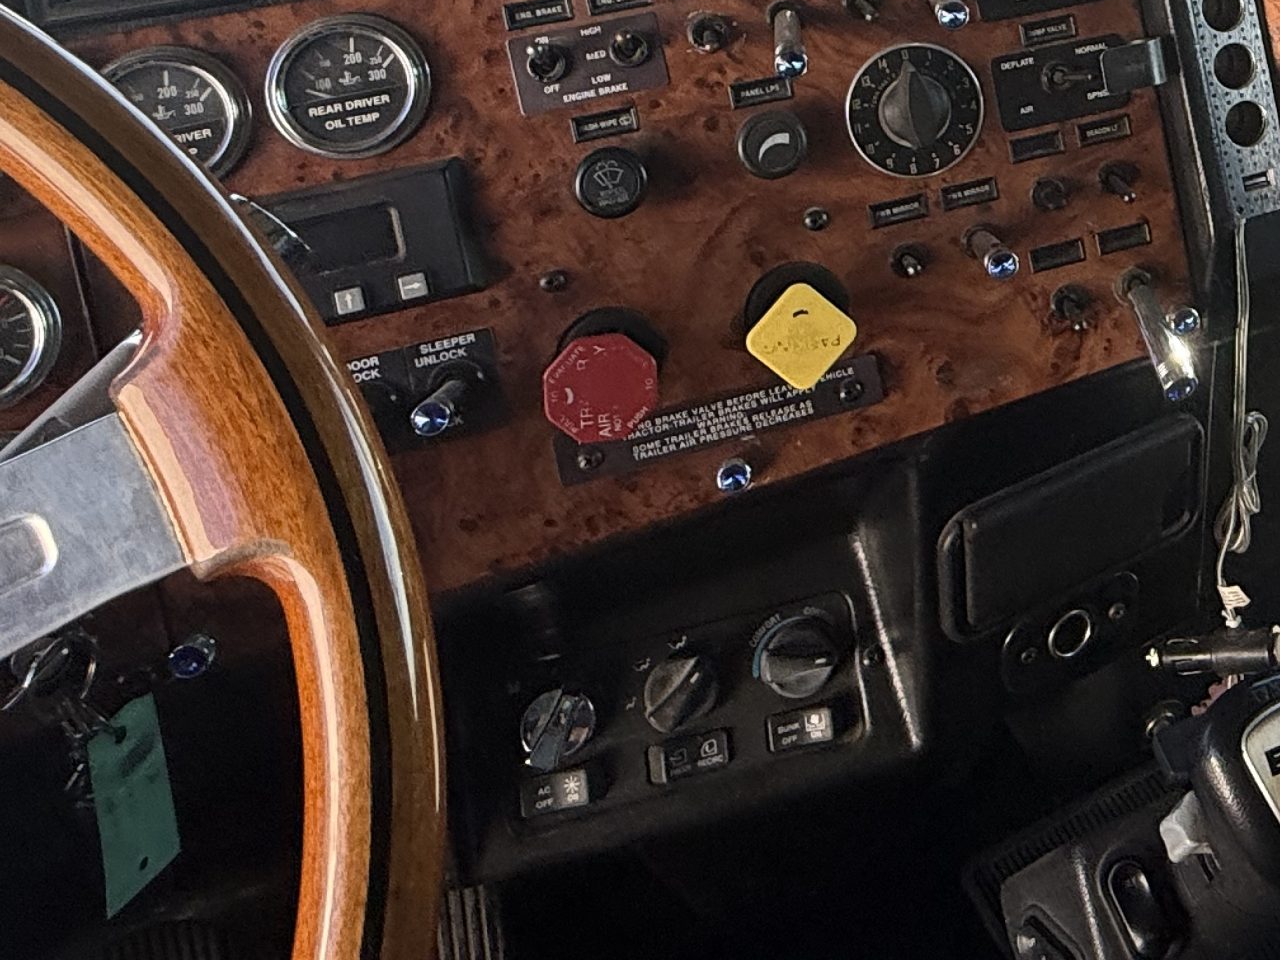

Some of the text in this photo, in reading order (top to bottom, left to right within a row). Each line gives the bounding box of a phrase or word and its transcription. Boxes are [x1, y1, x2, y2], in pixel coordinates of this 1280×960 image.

[535, 5, 563, 17] BRAKE
[580, 25, 602, 37] HIGH
[343, 52, 363, 65] 200
[585, 49, 606, 61] MED
[1000, 42, 1108, 71] DEFLATE NORMAL
[877, 58, 888, 70] 14
[367, 68, 387, 82] 300
[591, 73, 612, 85] LOW
[861, 75, 871, 87] 13
[315, 78, 332, 90] 100
[962, 77, 969, 88] 3
[157, 85, 178, 99] 200
[543, 83, 560, 95] OFF
[562, 82, 628, 103] ENGINE BRAKE
[740, 87, 765, 97] PANEL
[183, 102, 204, 116] 300
[308, 94, 391, 118] REAR DRIVER
[852, 99, 861, 110] 12
[970, 100, 977, 110] 4
[1020, 105, 1034, 115] AIR
[325, 112, 380, 131] OIL TEMP
[966, 124, 973, 135] 5
[173, 128, 212, 144] RIVER
[953, 144, 961, 156] 6
[886, 158, 894, 169] 9
[934, 157, 940, 169] 7
[419, 333, 476, 355] SLEEPER
[414, 347, 467, 368] UNLOCK
[655, 410, 689, 426] BRAKE
[692, 400, 724, 416] VALVE
[726, 390, 766, 407] BEFORE
[820, 367, 854, 383] HICLE
[717, 400, 759, 418] BRAKES
[760, 392, 784, 406] WILL
[626, 406, 649, 429] PUSH
[598, 413, 612, 437] AIR
[632, 400, 813, 454] SOME TRAILER BRAKES RELEASE AS
[633, 406, 814, 461] TRAILER AIR PRESSURE DECREASES
[781, 735, 798, 745] OFF
[537, 786, 550, 795] AC
[535, 798, 554, 809] OFF
